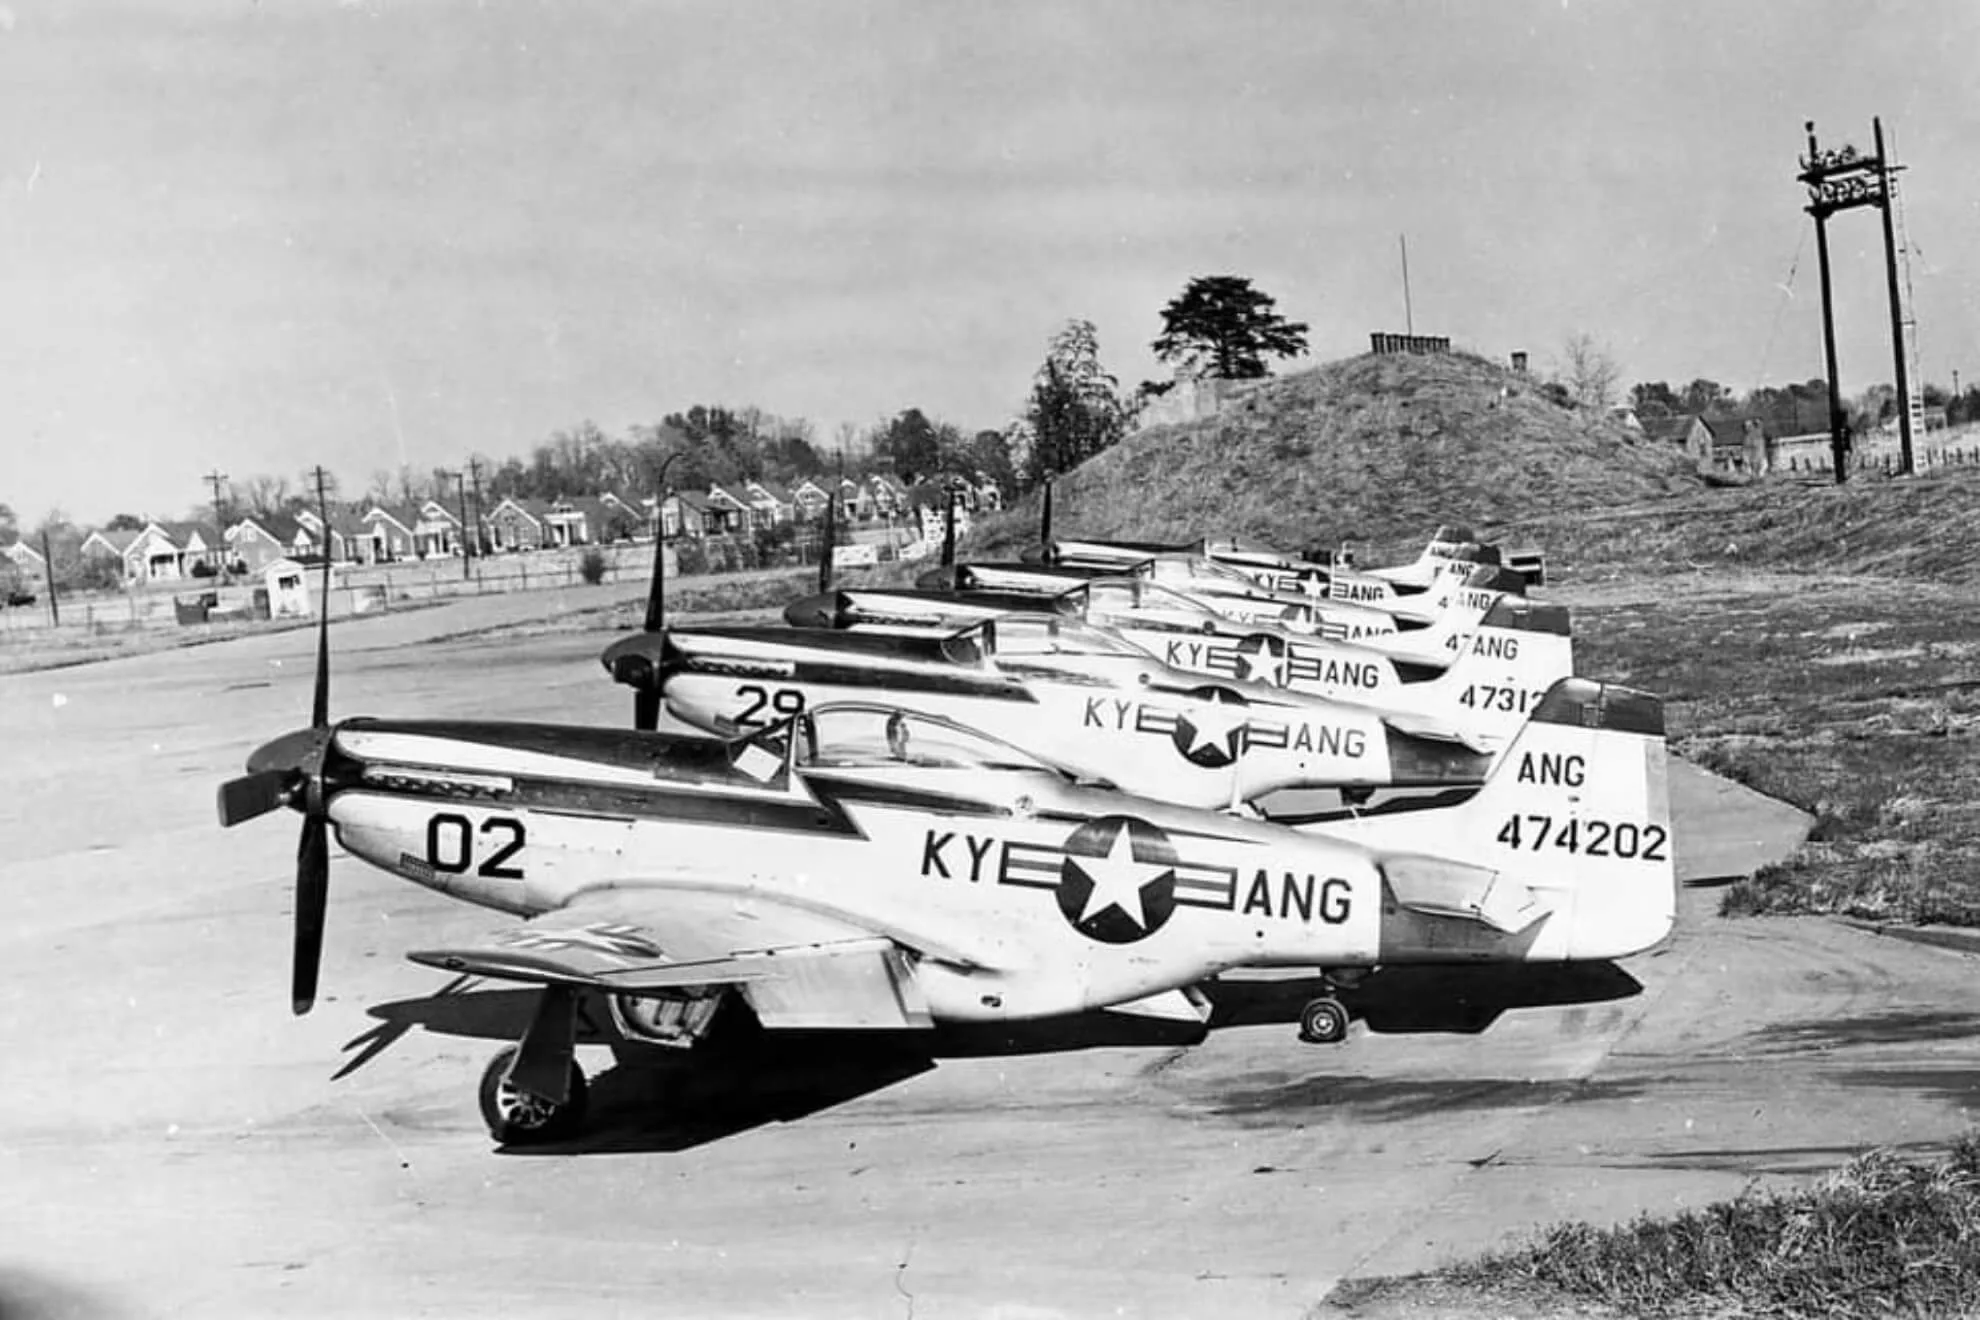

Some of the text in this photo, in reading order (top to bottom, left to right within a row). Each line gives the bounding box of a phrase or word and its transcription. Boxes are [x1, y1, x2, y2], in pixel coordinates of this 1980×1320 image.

[1350, 584, 1384, 601] ANG
[1456, 592, 1491, 611] ANG
[1167, 640, 1379, 689] KY ANG
[1472, 634, 1519, 660] ANG
[736, 686, 805, 726] 29
[1084, 696, 1366, 758] KY ANG
[1517, 751, 1585, 787] ANG
[427, 812, 526, 880] 02
[1497, 814, 1666, 861] 474202
[921, 829, 1352, 925] KY ANG
